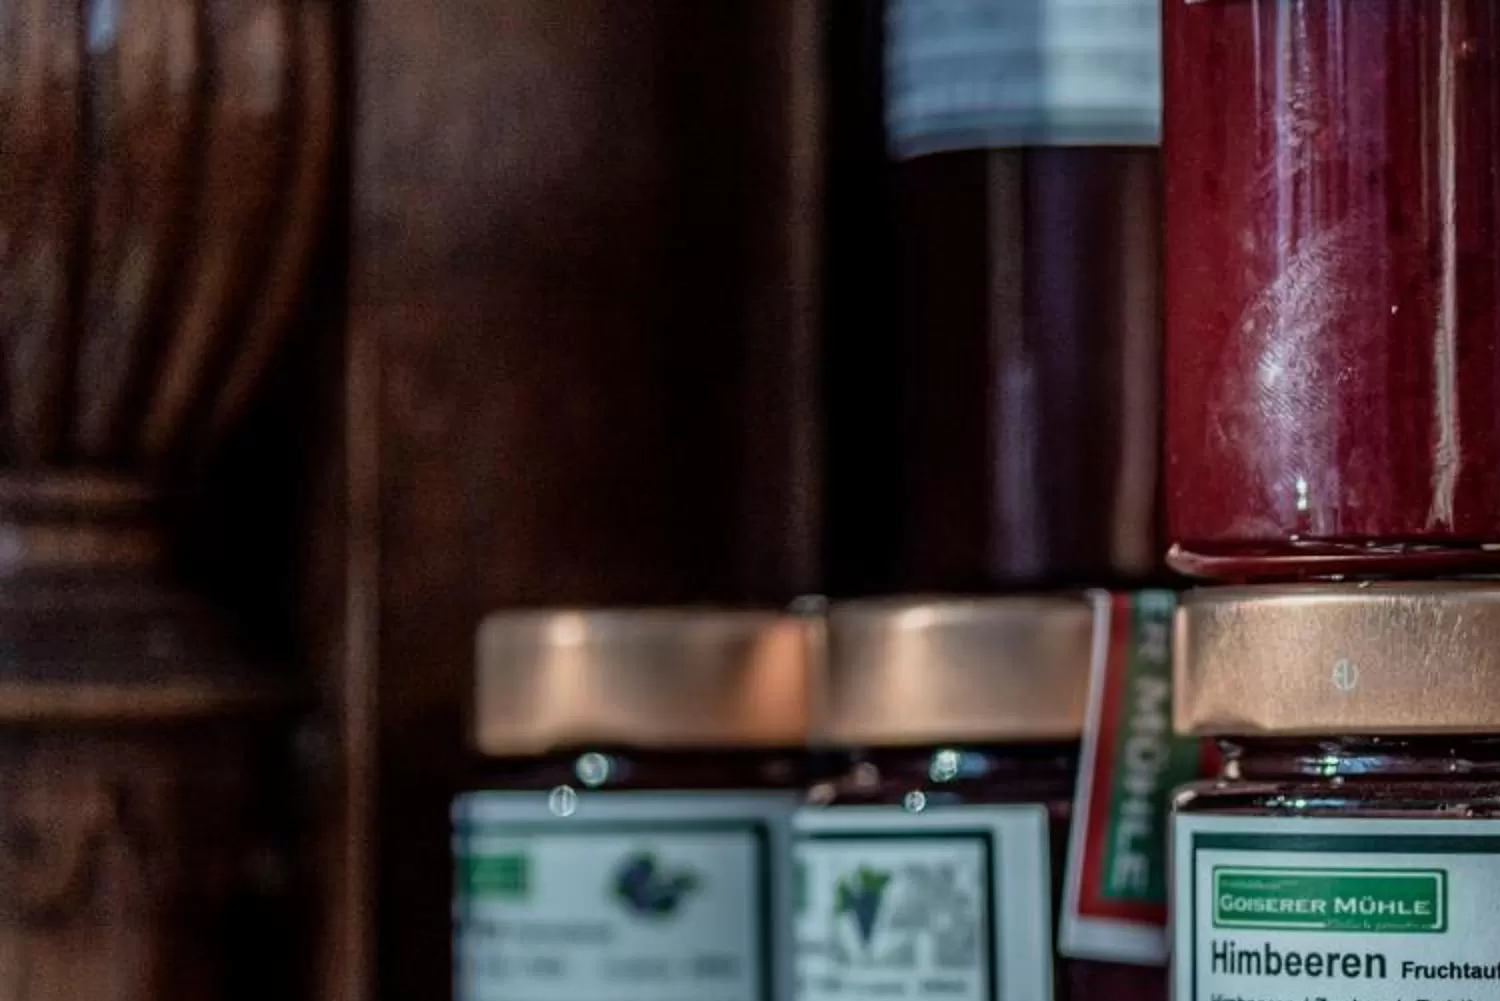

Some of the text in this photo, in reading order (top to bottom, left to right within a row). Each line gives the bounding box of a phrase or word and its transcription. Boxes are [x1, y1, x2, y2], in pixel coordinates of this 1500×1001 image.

[1219, 893, 1432, 916] GOISERER MÜHLE
[1211, 940, 1387, 979] Himbeeren
